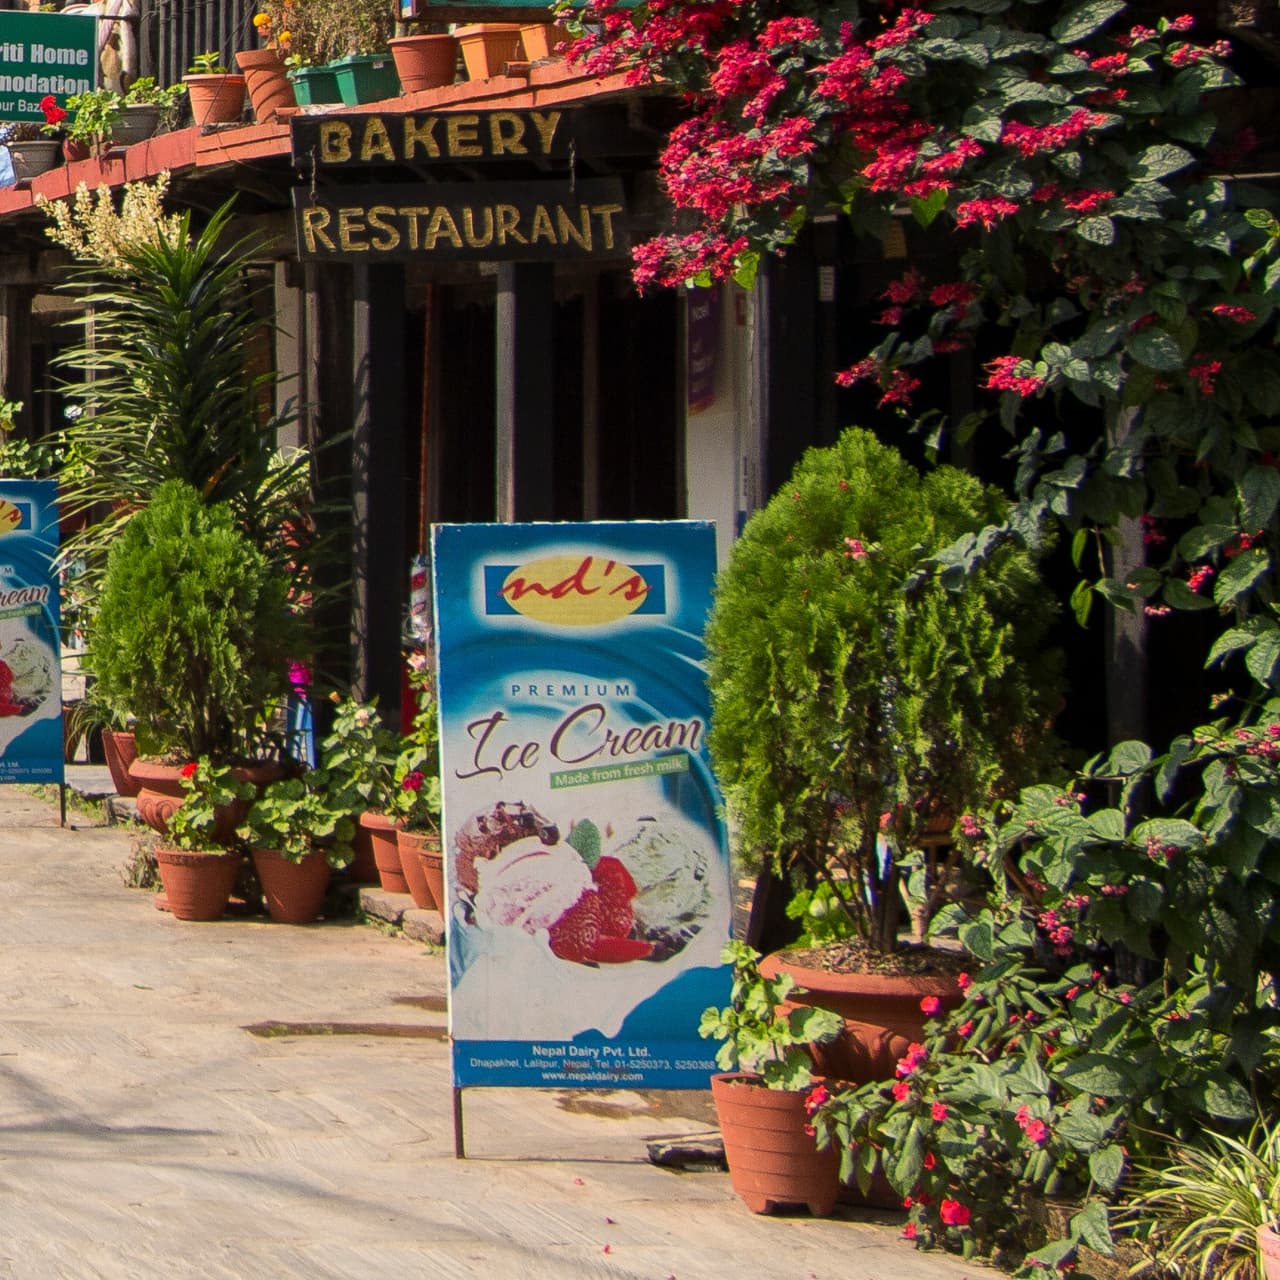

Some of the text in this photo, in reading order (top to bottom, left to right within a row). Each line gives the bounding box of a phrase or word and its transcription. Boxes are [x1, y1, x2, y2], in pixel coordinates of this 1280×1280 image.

[30, 44, 89, 66] Home
[320, 111, 561, 163] BAKERY
[303, 203, 623, 253] RESTAURANT
[497, 555, 653, 601] nd's
[512, 684, 631, 697] PREMIUM
[455, 703, 702, 780] Ice Cream
[555, 758, 683, 786] Made from fresh milk
[532, 1045, 651, 1059] Nepal Dairy Pvt. Ltd.
[542, 1072, 644, 1083] www.nepaldairy.com
